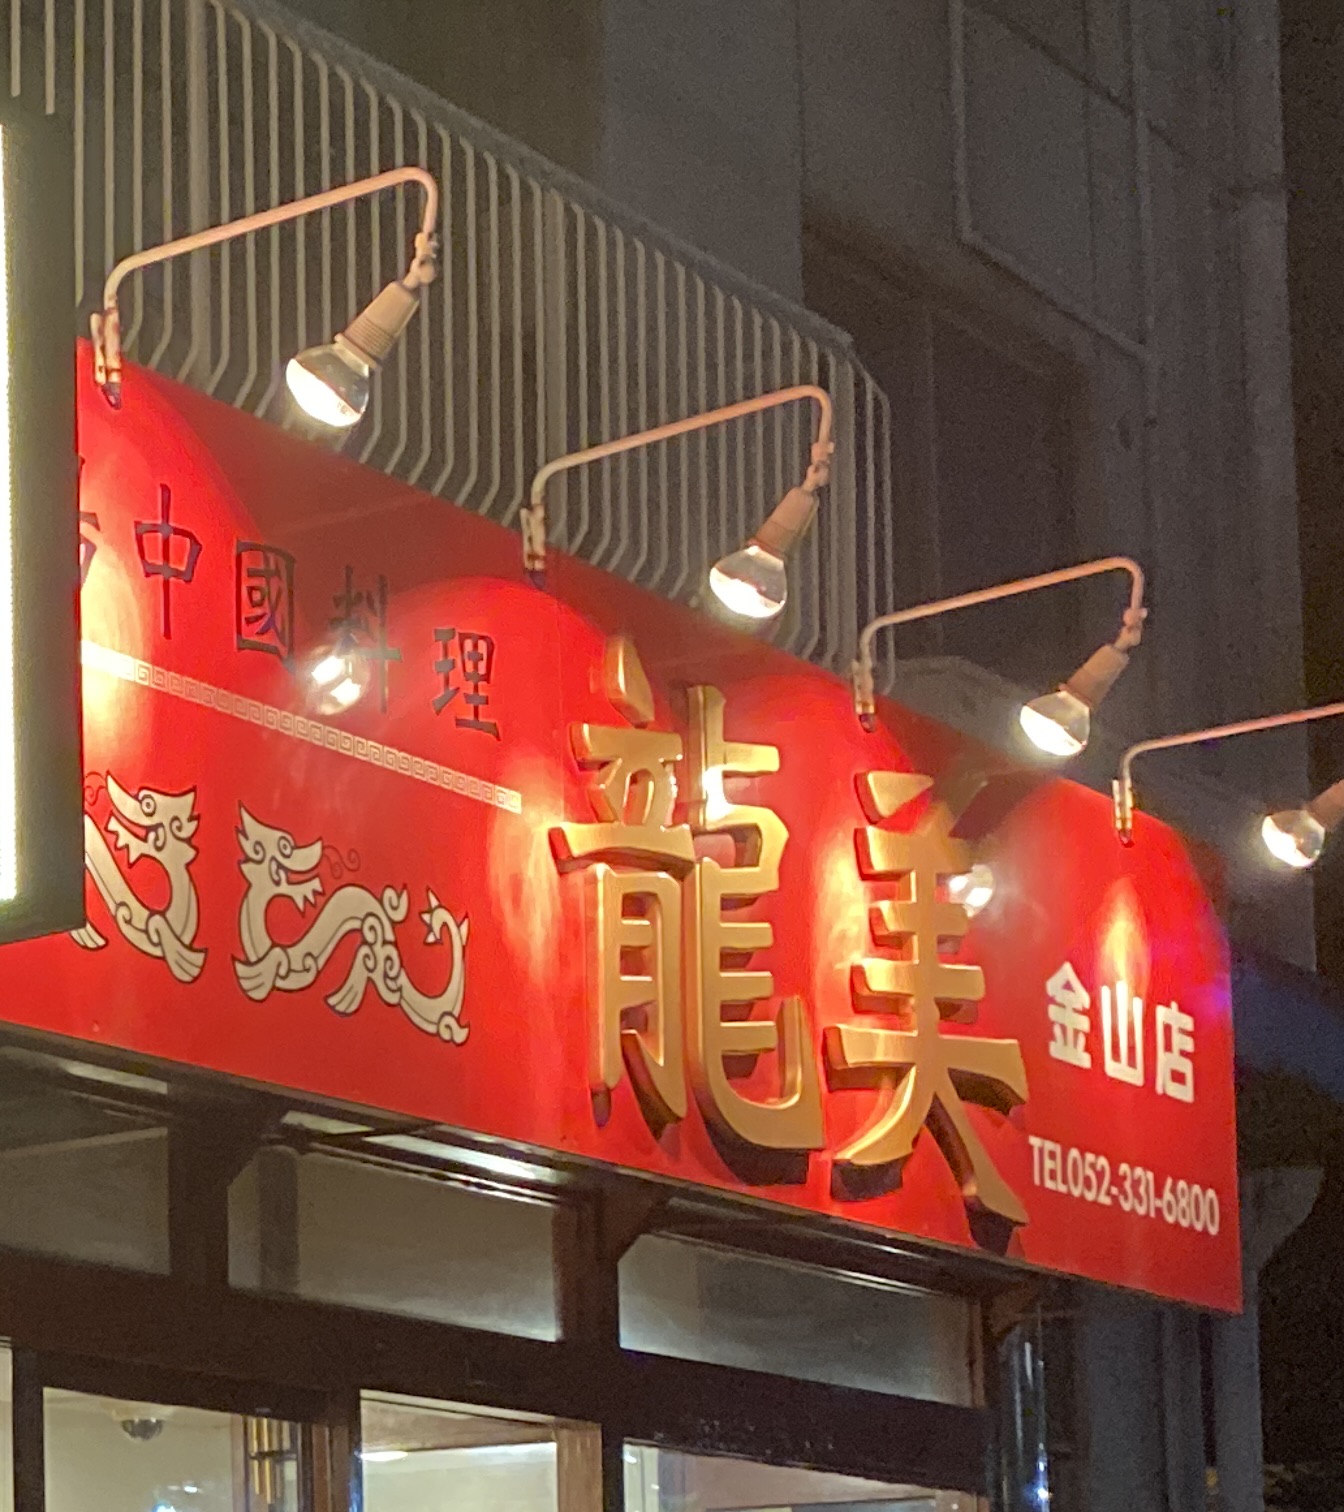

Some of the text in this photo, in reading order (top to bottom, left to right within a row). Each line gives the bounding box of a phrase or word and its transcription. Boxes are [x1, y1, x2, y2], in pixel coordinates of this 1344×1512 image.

[550, 636, 1028, 1256] 龍美
[1045, 959, 1195, 1104] 金山店
